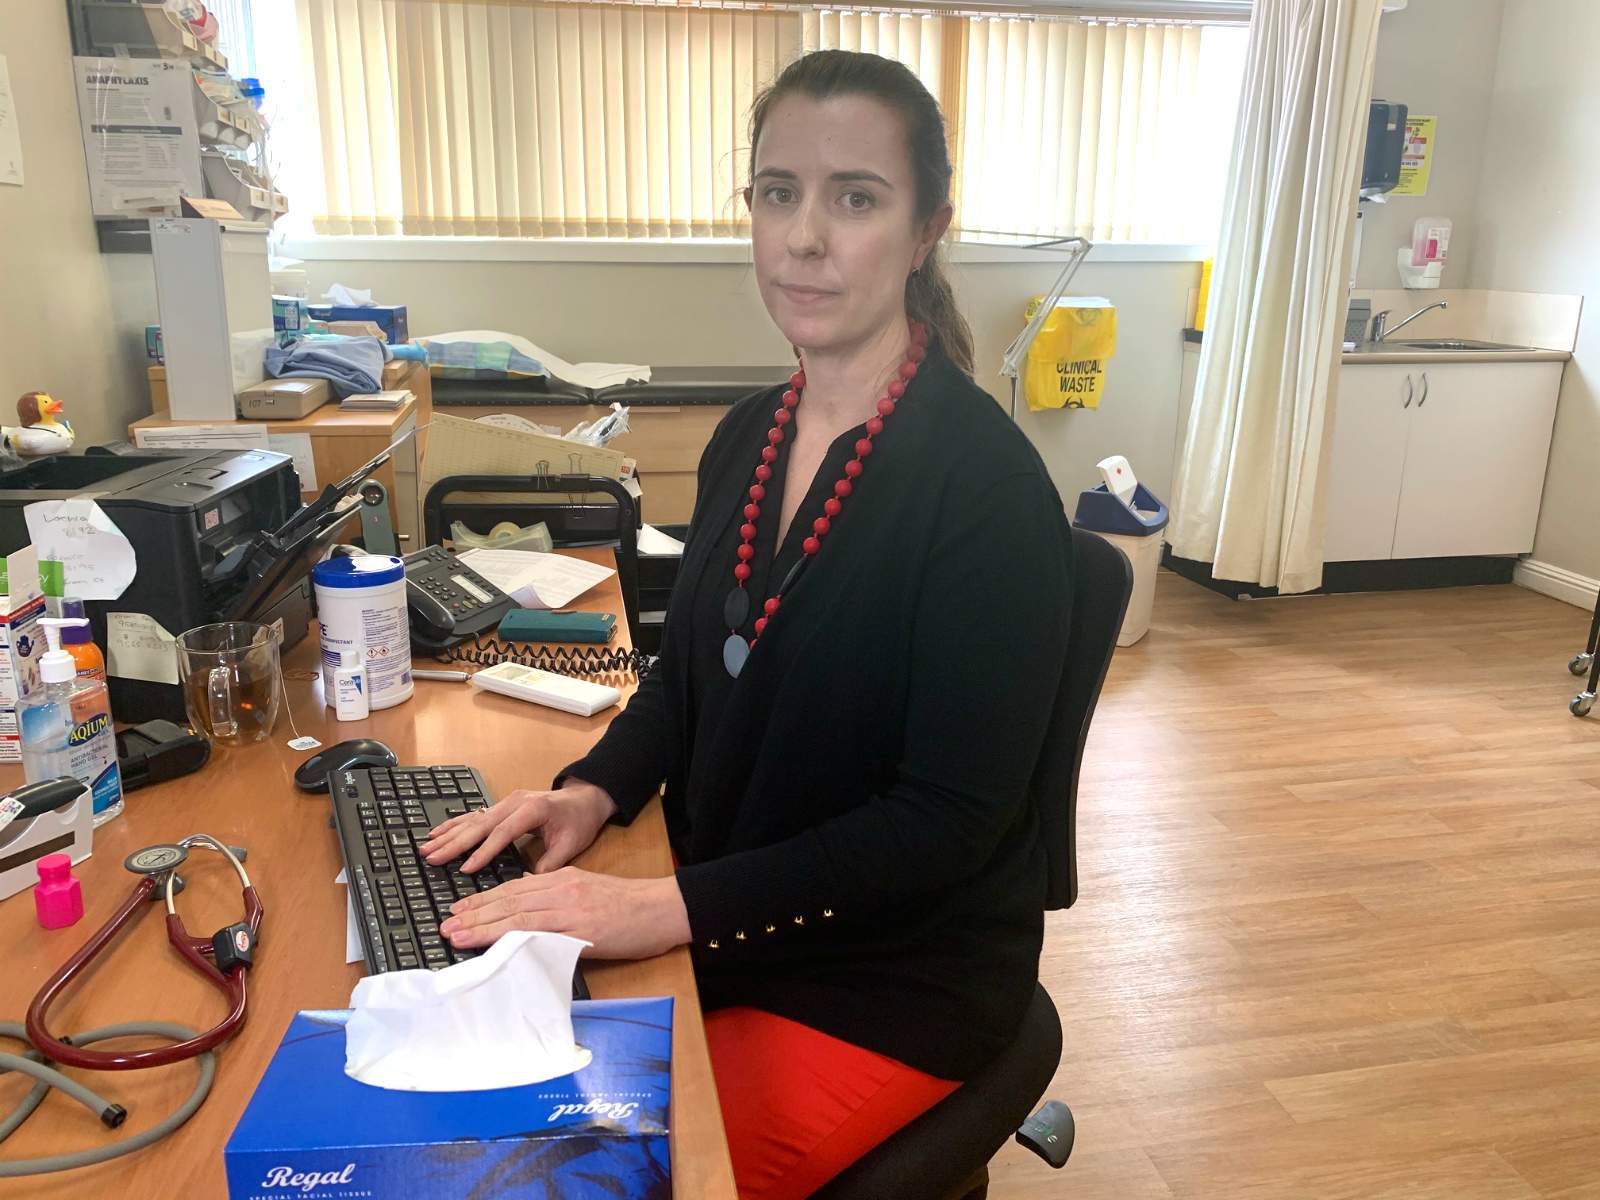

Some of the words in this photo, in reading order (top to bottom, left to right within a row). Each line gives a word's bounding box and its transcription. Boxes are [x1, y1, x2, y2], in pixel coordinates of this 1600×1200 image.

[86, 75, 149, 86] ANAPHYLAXIS
[1056, 359, 1103, 375] CLINICAL
[1060, 376, 1096, 393] WASTE
[70, 715, 108, 743] AQIUM
[547, 1099, 640, 1122] Regal
[261, 1163, 356, 1192] Regal
